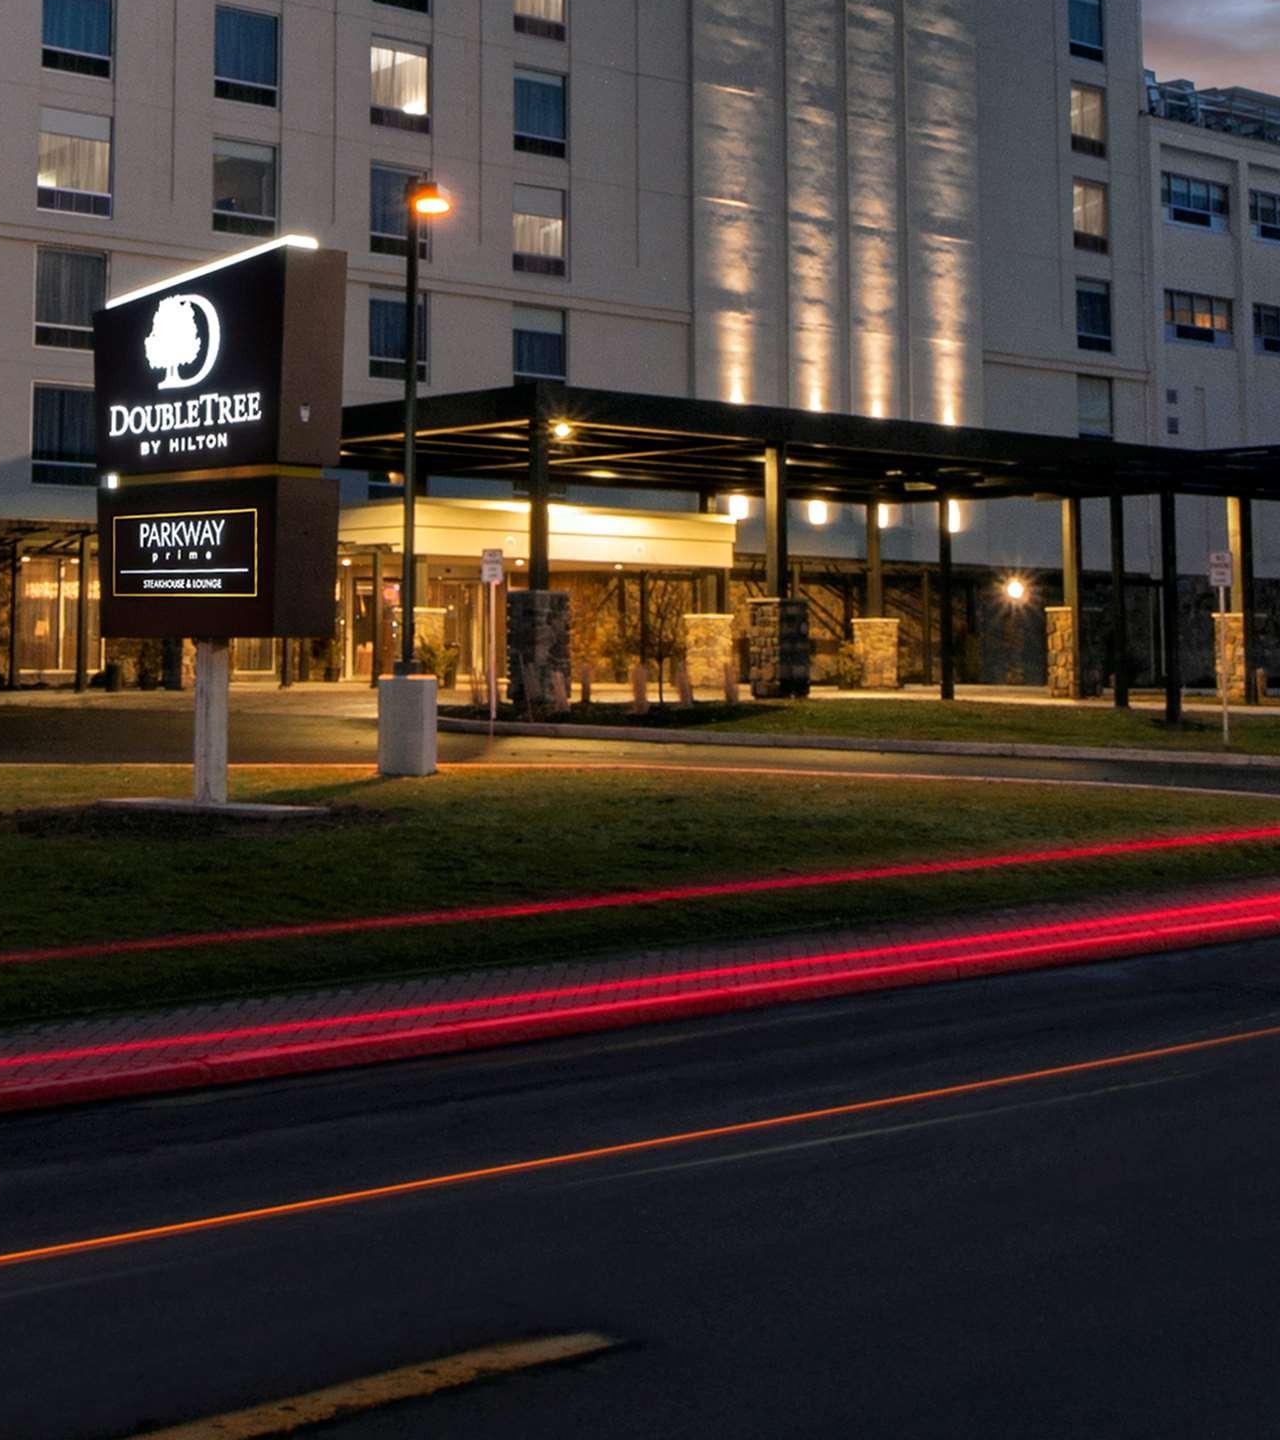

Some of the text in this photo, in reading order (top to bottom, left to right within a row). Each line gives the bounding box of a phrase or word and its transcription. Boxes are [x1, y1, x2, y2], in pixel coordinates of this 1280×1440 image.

[140, 432, 228, 456] BY HILTON
[140, 519, 225, 548] PARKWAY
[152, 549, 212, 563] prime
[143, 578, 222, 589] STEAKHOUSE & LOUNGE
